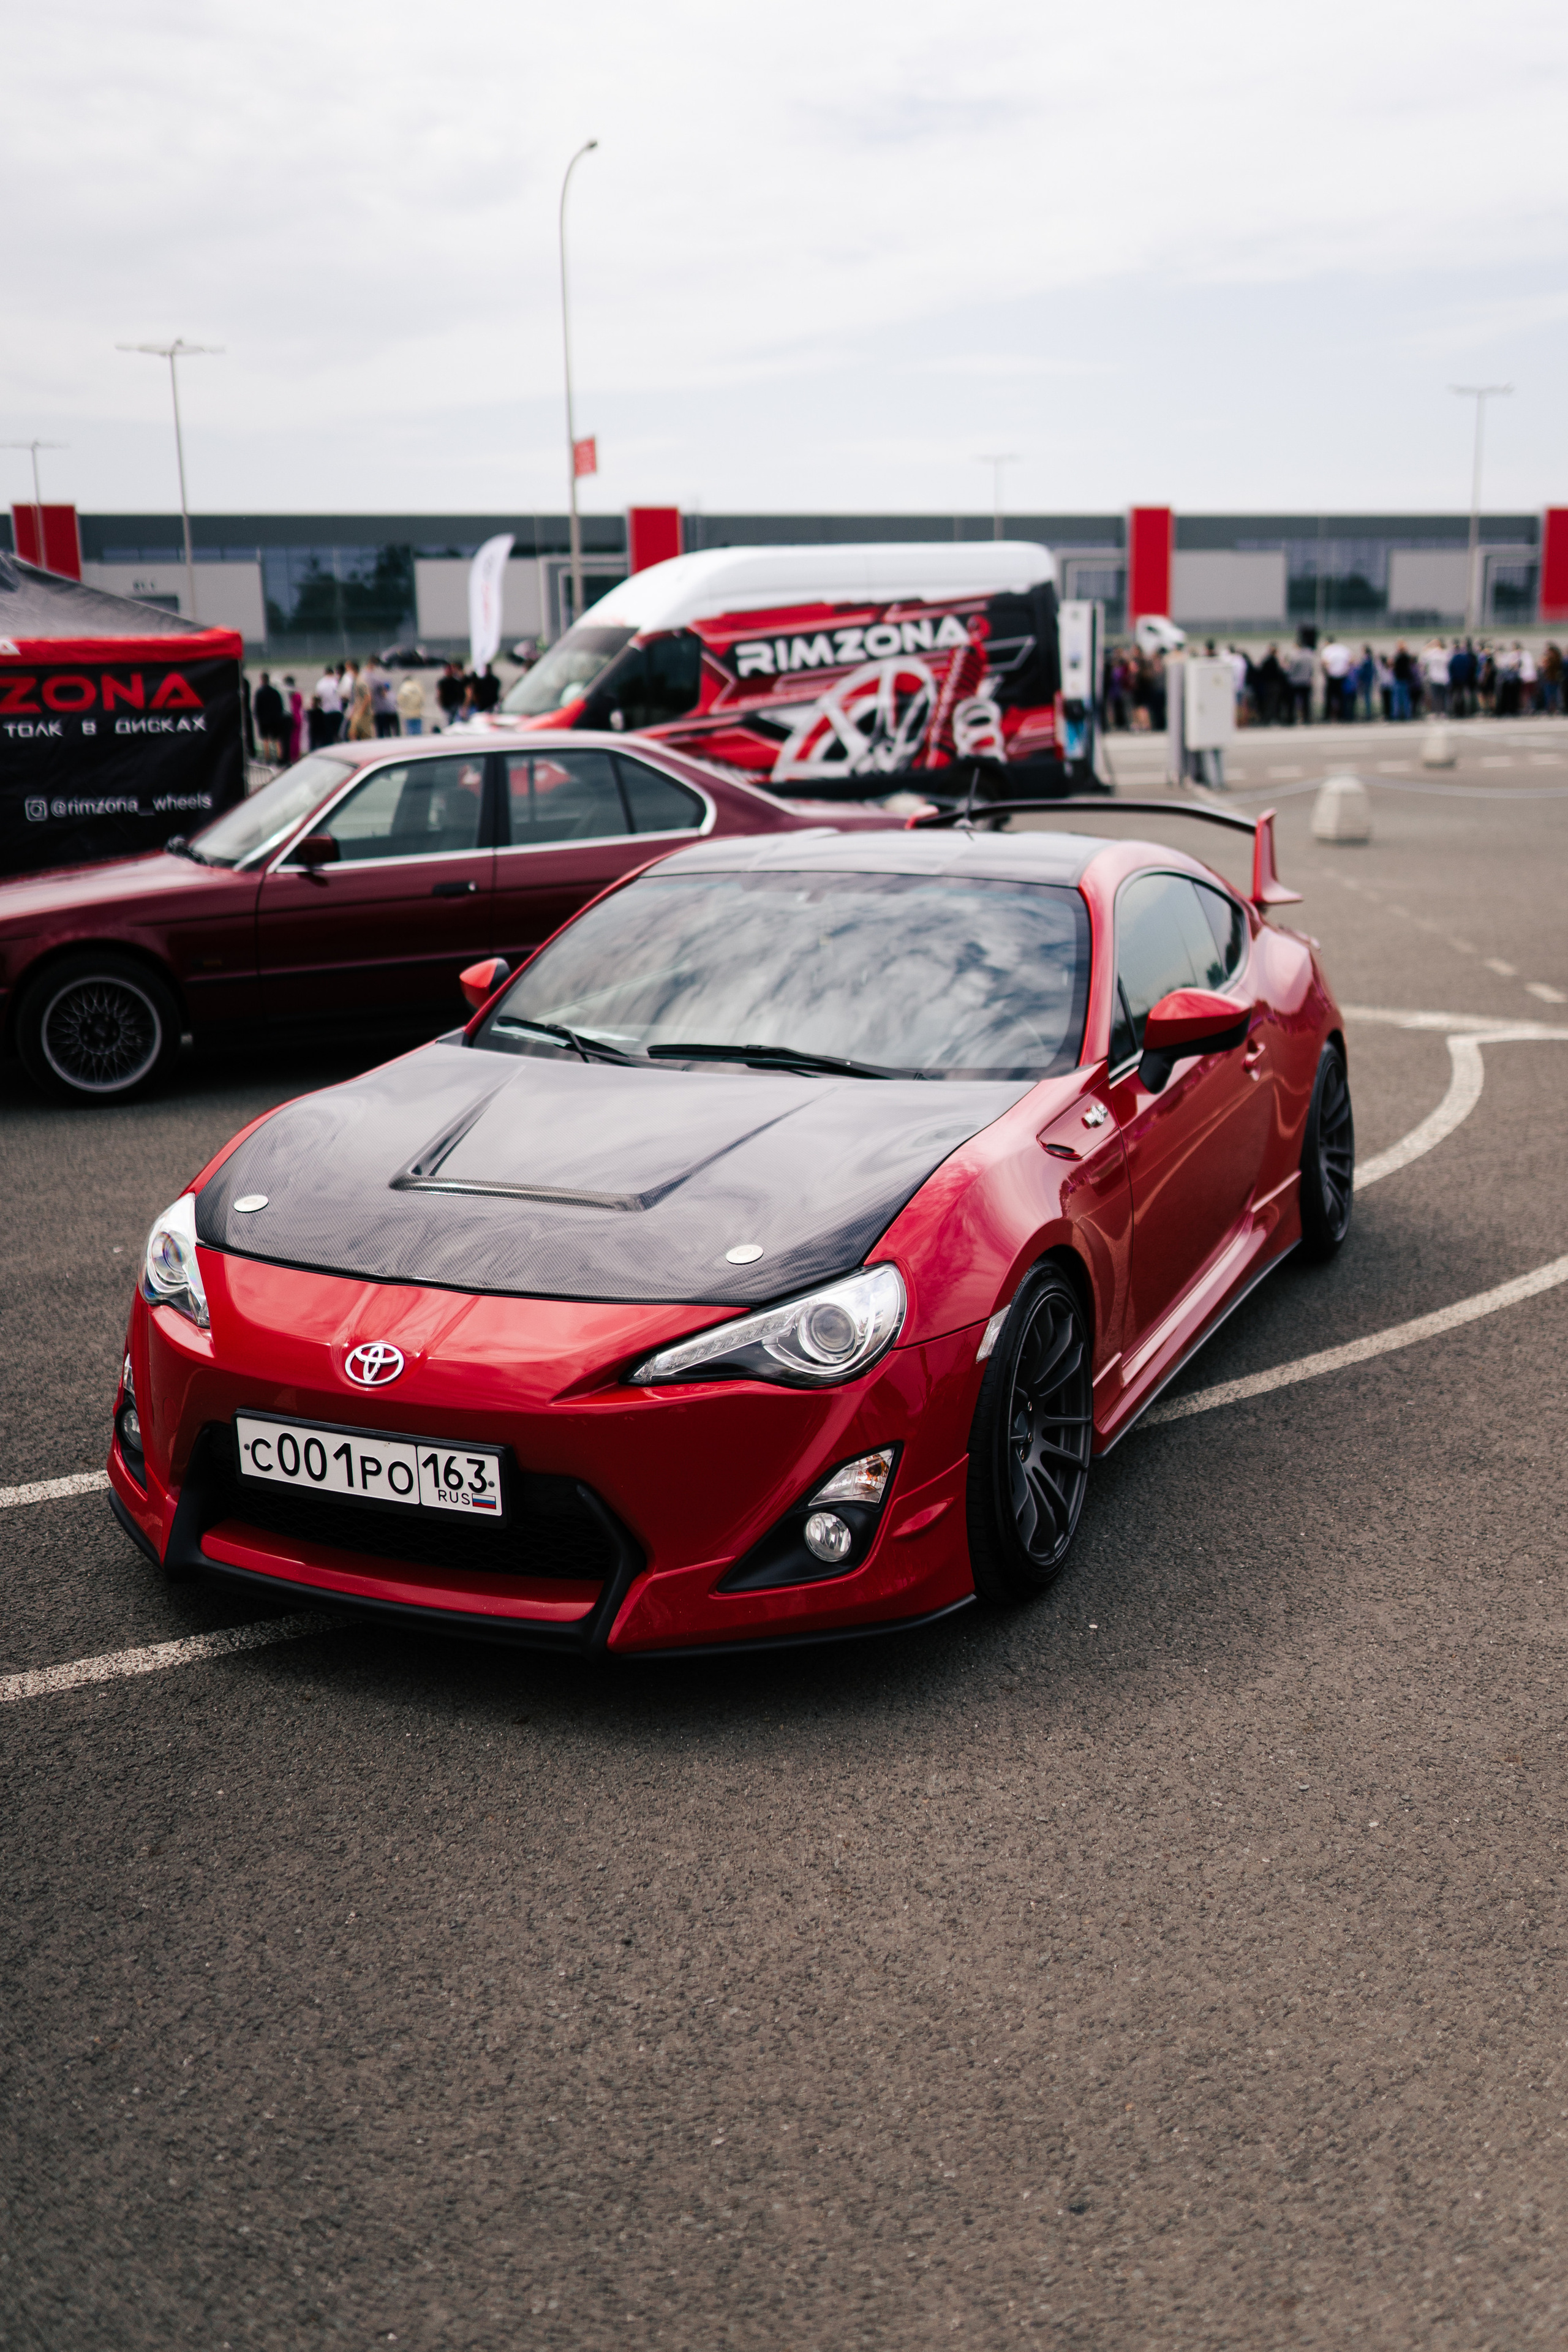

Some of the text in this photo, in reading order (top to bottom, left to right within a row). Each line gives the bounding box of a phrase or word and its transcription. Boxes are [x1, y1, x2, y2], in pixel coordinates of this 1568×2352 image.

[735, 615, 969, 678] RIMZONA
[0, 672, 205, 714] ZONA
[3, 714, 207, 739] ТОЛК В ДИСКАХ
[50, 793, 213, 818] @rimzona_wheels
[421, 1453, 488, 1494] 163
[437, 1490, 471, 1506] RUS
